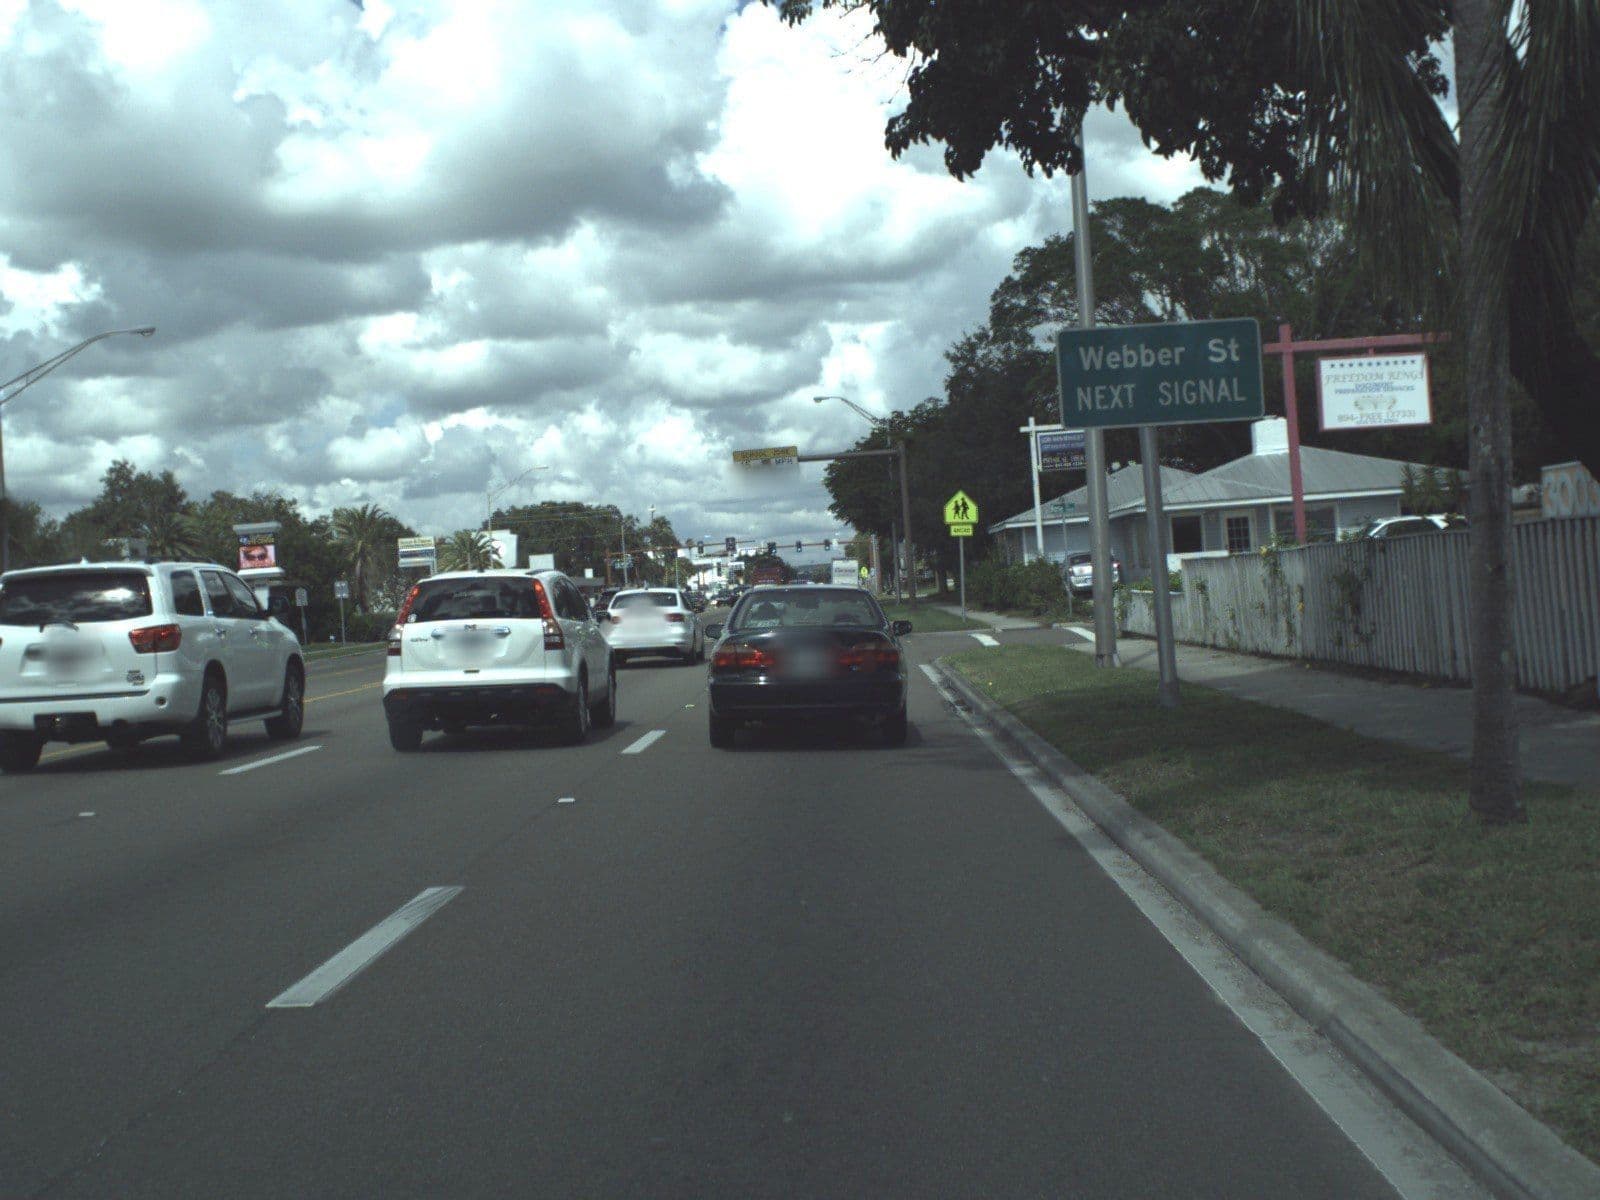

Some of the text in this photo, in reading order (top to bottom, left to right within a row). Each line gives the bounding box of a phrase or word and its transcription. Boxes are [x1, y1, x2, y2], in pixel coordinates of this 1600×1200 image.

[1079, 337, 1240, 371] Webber St
[1076, 377, 1247, 411] NEXT SIGNAL
[1325, 372, 1384, 384] FREEDOM
